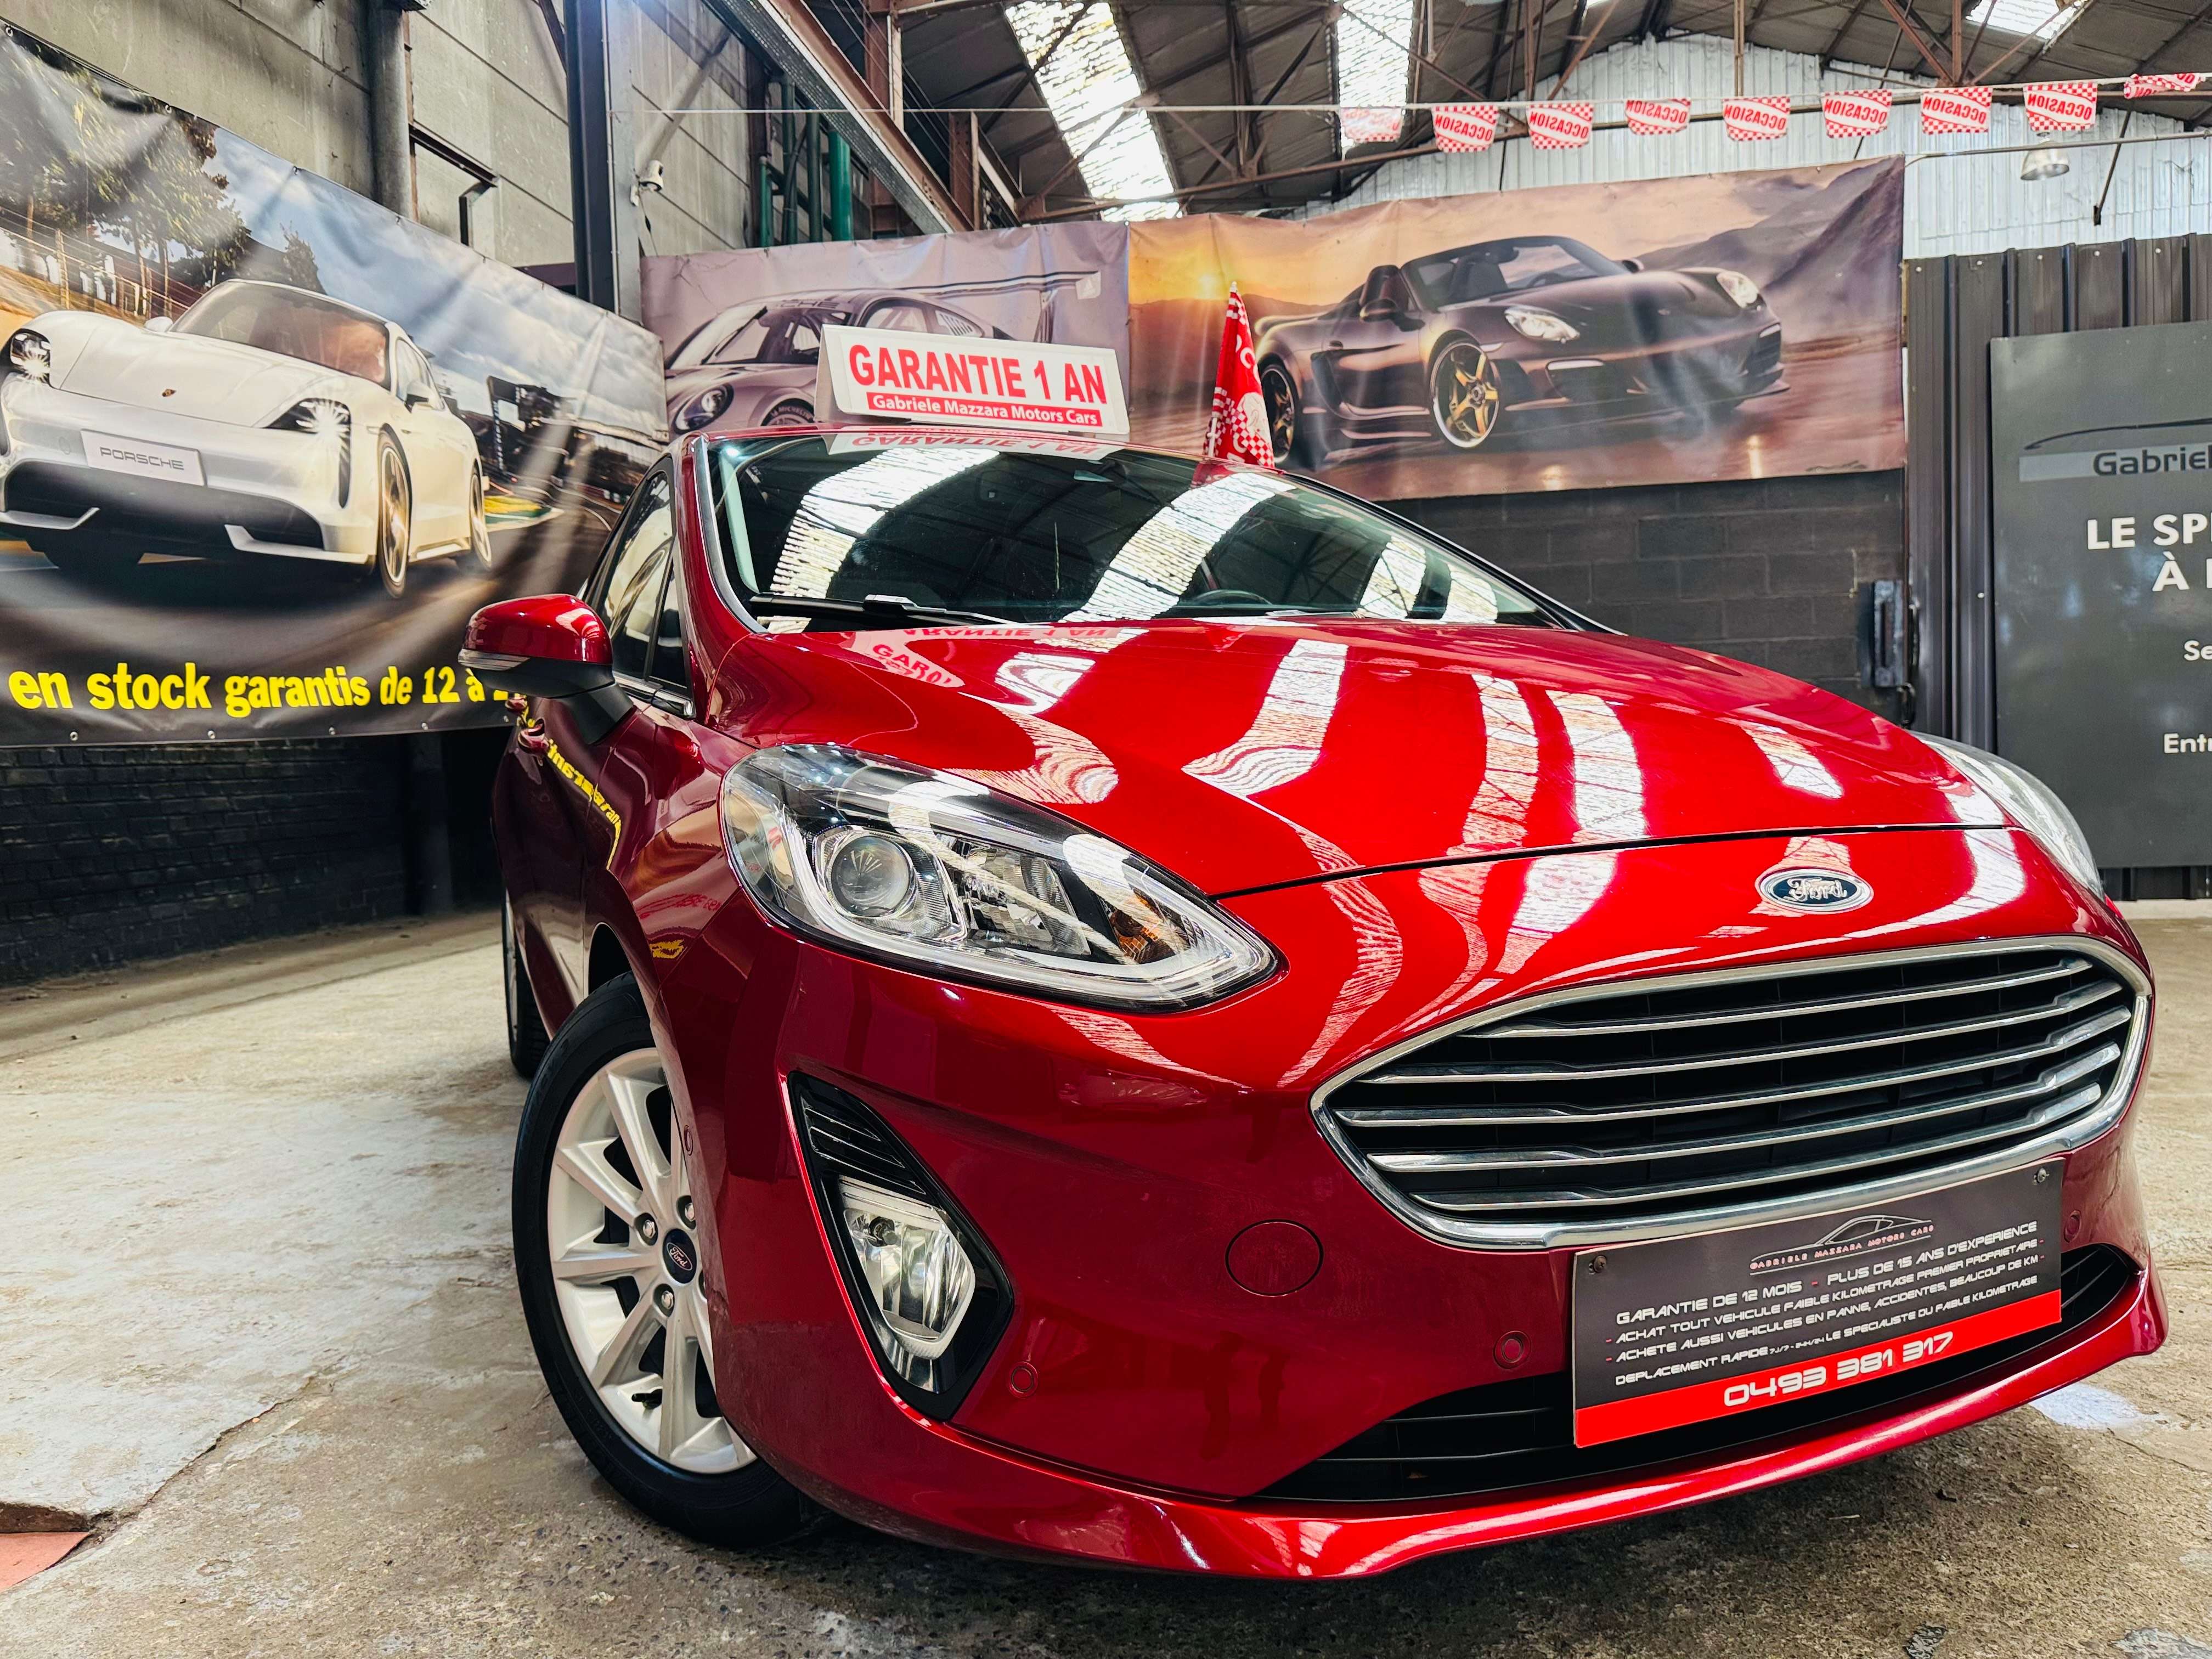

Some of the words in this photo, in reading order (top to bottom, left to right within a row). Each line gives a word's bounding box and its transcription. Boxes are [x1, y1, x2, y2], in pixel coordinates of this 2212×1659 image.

[849, 344, 1026, 398] GARANTIE
[1034, 359, 1051, 400] 1
[1064, 363, 1107, 404] AN
[873, 394, 940, 413] Gabriele
[945, 400, 1008, 417] Mazzara
[1011, 405, 1063, 422] Motors
[1066, 409, 1097, 425] Cars
[100, 447, 184, 470] PORSCHE
[2087, 517, 2135, 550] LE
[2153, 512, 2212, 546] SP
[2152, 551, 2190, 592] À
[9, 669, 73, 709] en
[87, 662, 212, 712] stock
[224, 665, 370, 718] garantis
[380, 666, 411, 706] de
[421, 665, 461, 704] 12
[1783, 877, 1847, 902] Ford
[670, 1246, 687, 1267] Ford
[1750, 1253, 1807, 1269] GABRIELE
[1867, 1232, 1904, 1247] MOTORS
[1911, 1224, 1934, 1236] CARS
[1616, 1298, 1708, 1325] GARANTIE
[1713, 1293, 1737, 1308] DE
[1742, 1289, 1758, 1302] 12
[1762, 1280, 1802, 1298] MOIS
[1827, 1267, 1870, 1285] PLUS
[1873, 1260, 1894, 1275] DE
[1897, 1256, 1912, 1269] 15
[1916, 1247, 1944, 1265] ANS
[1947, 1221, 2037, 1256] D'EXPERIENCE
[1616, 1326, 1666, 1343] ACHAT
[1670, 1317, 1711, 1334] TOUT
[1714, 1304, 1781, 1325] VEHICULE
[1784, 1294, 1829, 1312] FAIBLE
[1832, 1273, 1914, 1301] KILOMETRAGE
[1917, 1260, 1963, 1281] PREMIER
[1966, 1239, 2038, 1267] PROPRIETAIRE
[1615, 1357, 1718, 1386] DEPLACEMENT
[1720, 1346, 1768, 1364] RAPIDE
[1826, 1330, 1841, 1341] LE
[1843, 1310, 1916, 1337] SPECIALISTE
[1918, 1306, 1933, 1317] DU
[1935, 1296, 1970, 1313] FAIBLE
[1972, 1275, 2038, 1302] KILOMETRAGE
[1616, 1342, 1677, 1362] ACHETE
[1680, 1333, 1724, 1350] AUSSI
[1727, 1317, 1802, 1340] VEHICULES
[1805, 1313, 1824, 1325] EN
[1826, 1302, 1871, 1321] PANNE,
[1874, 1282, 1947, 1308] ACCIDENTES,
[1949, 1263, 2005, 1289] BEAUCOUP
[2008, 1259, 2022, 1271] DE
[2024, 1254, 2038, 1266] KM
[1724, 1366, 1826, 1407] 0493
[1837, 1348, 1893, 1380] 381
[1903, 1331, 1953, 1362] 317
